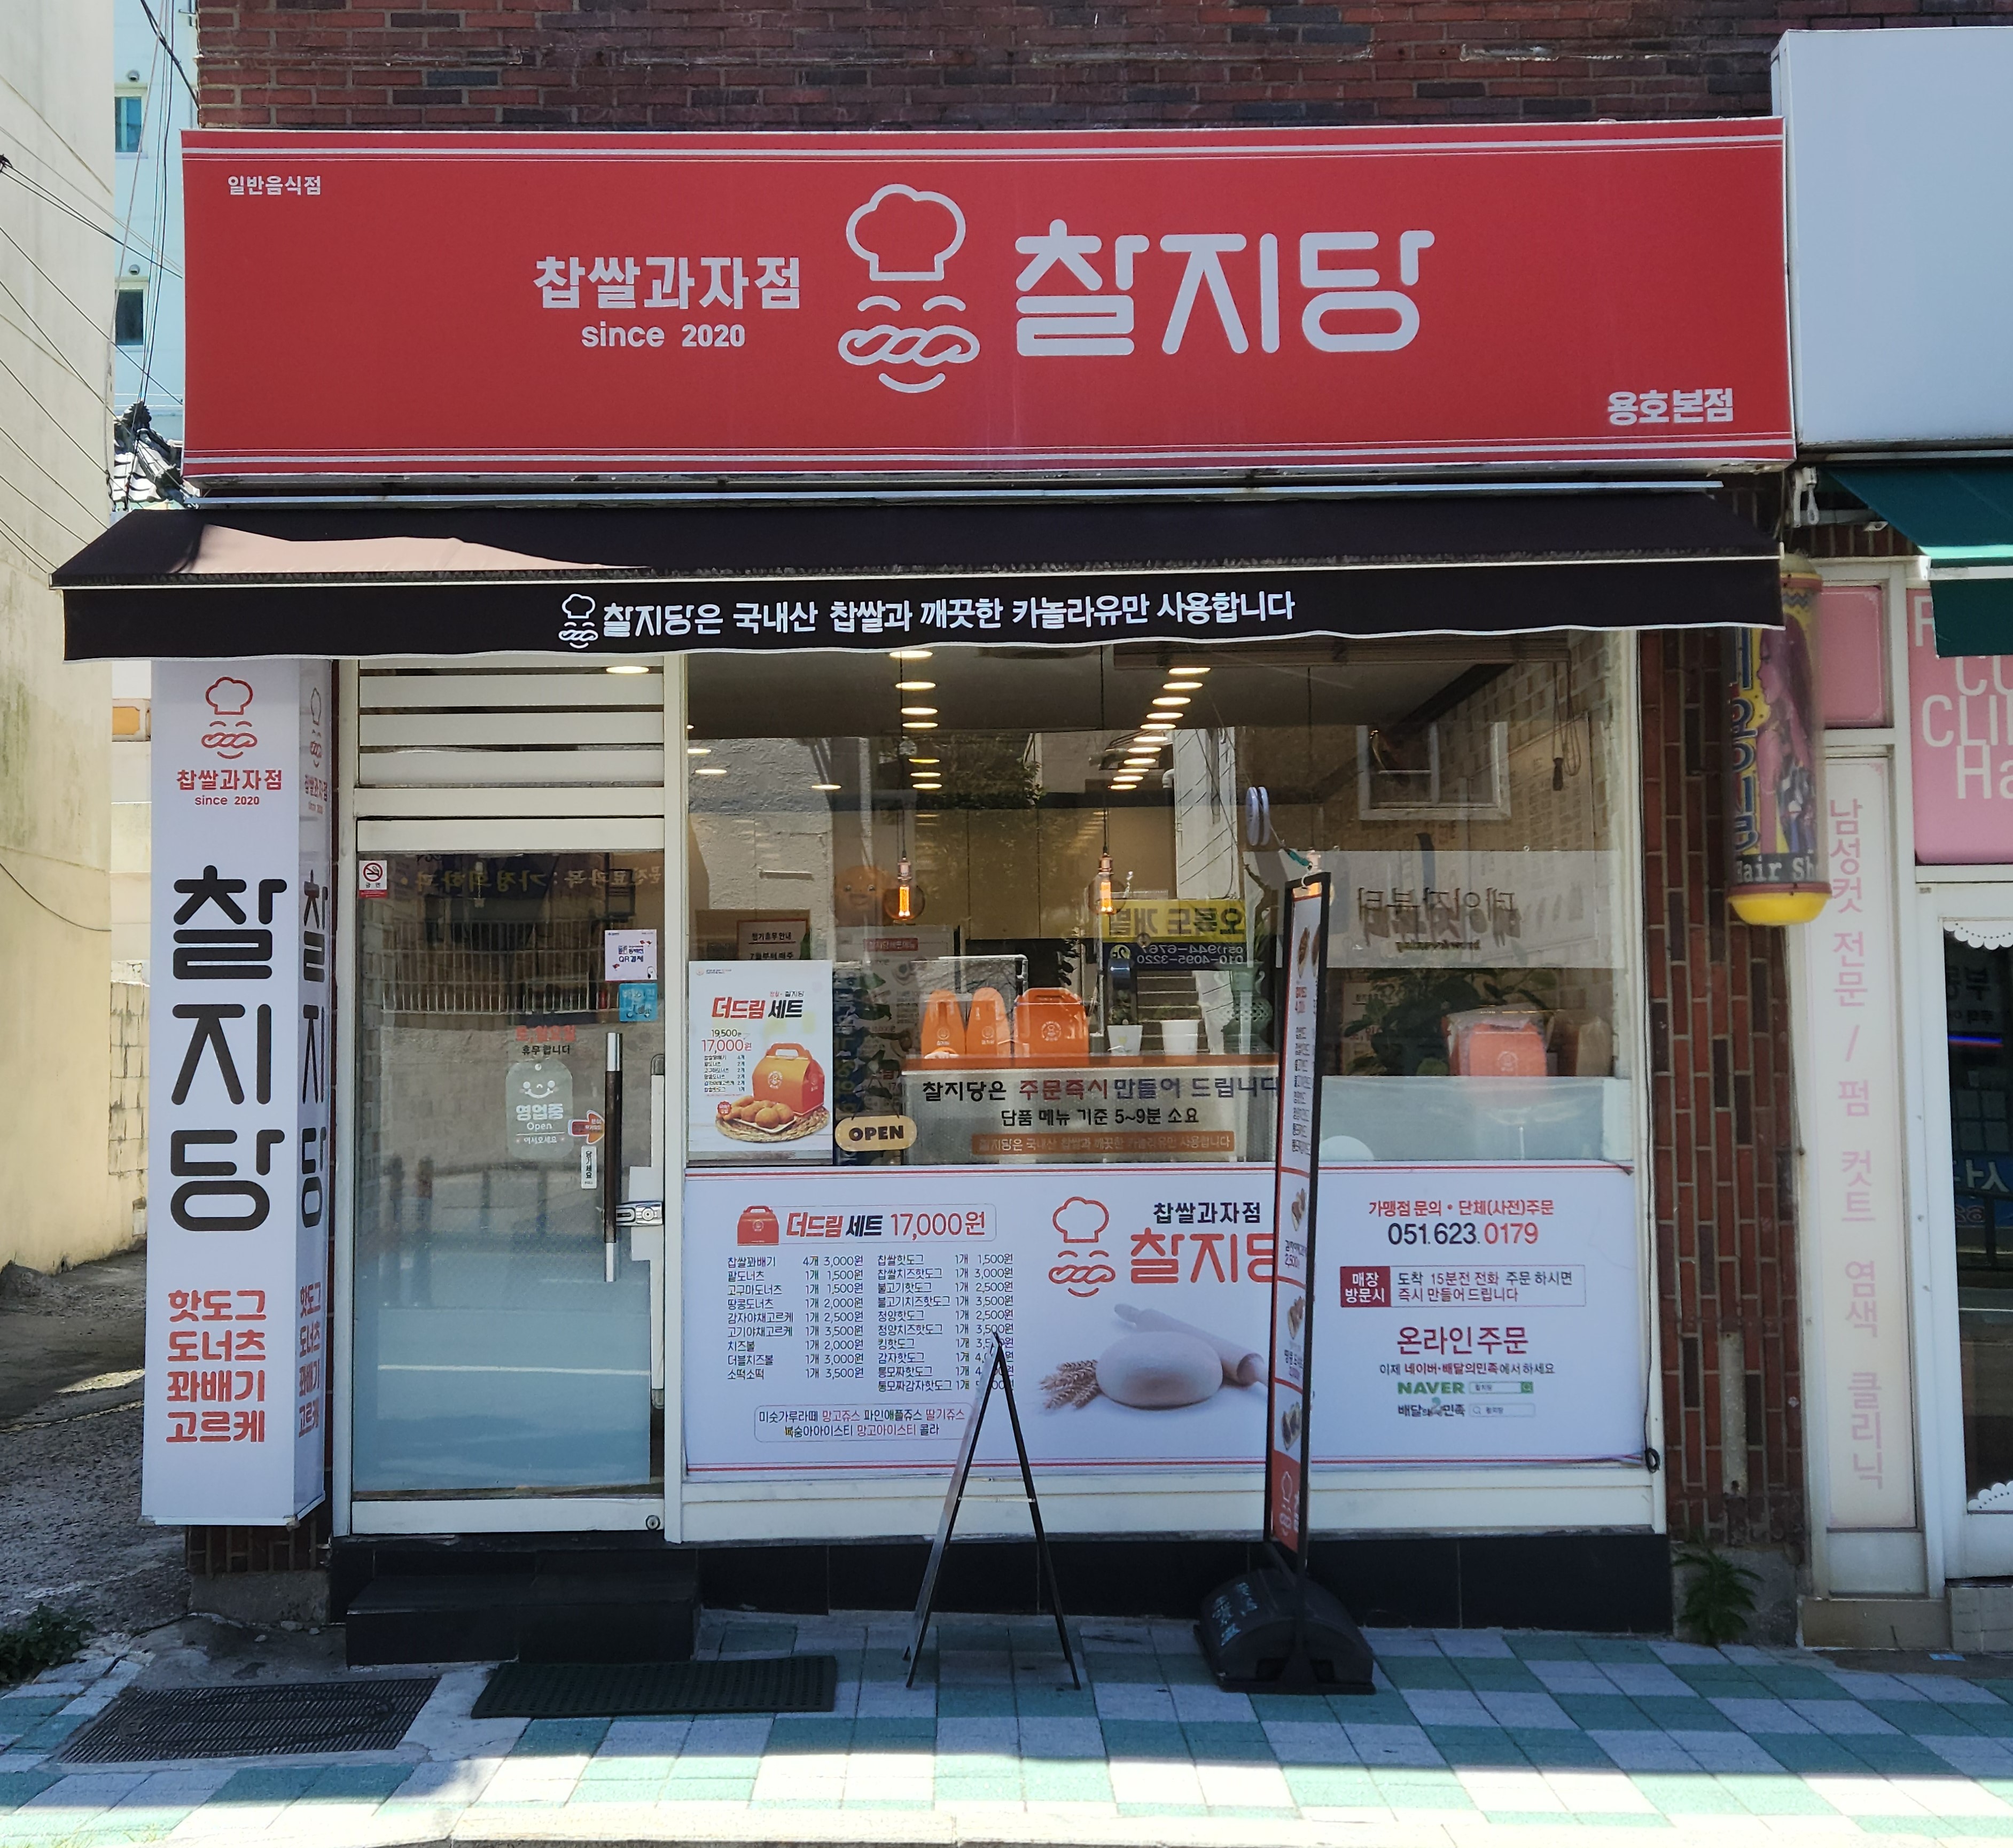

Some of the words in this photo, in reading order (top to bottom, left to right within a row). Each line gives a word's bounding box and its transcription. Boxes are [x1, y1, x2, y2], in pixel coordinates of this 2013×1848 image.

[228, 174, 322, 197] 일반음식점
[534, 256, 800, 310] 찹쌀과자점
[1015, 218, 1435, 356] 찰지당
[582, 322, 664, 348] since
[682, 324, 746, 348] 2020
[1607, 387, 1734, 425] 용호본점
[603, 603, 723, 637] 찰지당은
[733, 601, 818, 634] 국내산
[830, 601, 913, 633] 찹쌀과
[920, 598, 1003, 629] 깨끗한
[1013, 594, 1150, 629] 카놀라유만
[1157, 591, 1296, 626] 사용합니다
[1923, 695, 2013, 746] CLI
[176, 769, 283, 791] 찹쌀과자점
[195, 795, 228, 806] since
[234, 796, 260, 806] 2020
[1830, 799, 1863, 914] 남성컷
[1833, 931, 1868, 1007] 전문
[712, 997, 766, 1019] 더드림
[768, 1000, 803, 1019] 세트
[170, 865, 287, 1231] 찰지당
[701, 1040, 752, 1054] 17,000원
[923, 1080, 1007, 1102] 찰지당은
[1019, 1079, 1107, 1101] 주문즉시
[1114, 1078, 1180, 1099] 만들어
[1838, 1080, 1870, 1117] 펌
[516, 1104, 563, 1121] 영업중
[1001, 1109, 1032, 1126] 단품
[1039, 1108, 1070, 1126] 메뉴
[1077, 1108, 1107, 1125] 기준
[1114, 1108, 1161, 1125] 5~9분
[1168, 1108, 1199, 1122] 소요
[527, 1122, 552, 1130] Open
[848, 1126, 904, 1143] OPEN
[1841, 1150, 1876, 1222] 컷트
[1153, 1202, 1261, 1224] 찹쌀과자점
[1369, 1200, 1411, 1217] 가맹점
[1414, 1200, 1442, 1217] 문의
[1459, 1199, 1554, 1216] 단체(사전)주문
[786, 1212, 844, 1238] 더드림
[845, 1214, 883, 1237] 세트
[890, 1211, 986, 1241] 17,000원
[1388, 1222, 1539, 1245] 051.623.0179
[728, 1257, 775, 1268] 찹쌀꽈배기
[803, 1256, 818, 1266] 4개
[824, 1255, 863, 1268] 3,000원
[878, 1254, 924, 1266] 찹쌀핫도그
[955, 1254, 968, 1264] 1개
[978, 1253, 1013, 1265] 1,500원
[728, 1270, 764, 1282] 팥도너츠
[806, 1270, 818, 1280] 1개
[827, 1269, 863, 1281] 1,500원
[878, 1268, 942, 1280] 찹쌀치즈핫도그
[955, 1268, 968, 1278] 1개
[974, 1267, 1013, 1280] 3,000원
[1352, 1272, 1379, 1288] 매장
[1398, 1272, 1423, 1286] 도착
[1431, 1272, 1470, 1286] 15분전
[1474, 1272, 1499, 1286] 전화
[1506, 1272, 1531, 1286] 주문
[1534, 1272, 1572, 1286] 하시면
[806, 1284, 818, 1294] 1개
[827, 1283, 863, 1294] 1,500원
[955, 1282, 968, 1292] 1개
[976, 1281, 1013, 1293] 2,500원
[1345, 1288, 1385, 1303] 방문시
[1398, 1288, 1423, 1302] 즉시
[1427, 1288, 1465, 1302] 만들어
[1468, 1288, 1518, 1302] 드립니다
[168, 1290, 267, 1323] 핫도그
[728, 1298, 774, 1310] 땅콩도너츠
[805, 1298, 818, 1308] 1개
[824, 1297, 863, 1309] 2,000원
[956, 1296, 969, 1306] 1개
[976, 1295, 1013, 1307] 3,500원
[1845, 1261, 1878, 1337] 염색
[728, 1312, 793, 1324] 감자야채고르케
[806, 1312, 818, 1322] 1개
[824, 1311, 863, 1323] 2,500원
[956, 1309, 969, 1320] 1개
[976, 1309, 1013, 1321] 2,500원
[728, 1326, 792, 1337] 고기야채고르케
[806, 1325, 818, 1336] 1개
[825, 1325, 863, 1337] 3,500원
[955, 1323, 969, 1334] 1개
[167, 1330, 266, 1362] 도너츠
[728, 1340, 754, 1352] 치즈볼
[806, 1339, 819, 1351] 1개
[824, 1339, 863, 1352] 2,000원
[976, 1337, 1013, 1350] 3,50원
[1397, 1326, 1471, 1355] 온라인
[1478, 1327, 1528, 1355] 주문
[728, 1355, 774, 1366] 더블치즈볼
[805, 1354, 819, 1364] 1개
[824, 1353, 863, 1365] 3,000원
[878, 1352, 925, 1364] 감자핫도그
[975, 1351, 1013, 1364] 4,원
[728, 1368, 764, 1380] 소떡소떡
[806, 1368, 819, 1378] 1개
[825, 1367, 864, 1379] 3,500원
[1380, 1364, 1400, 1375] 이제
[167, 1369, 266, 1402] 꽈배기
[1398, 1382, 1465, 1394] NAVER
[759, 1410, 818, 1423] 미숫가루라떼
[822, 1410, 860, 1422] 망고쥬스
[864, 1409, 922, 1422] 파인애플쥬스
[926, 1408, 965, 1421] 딸기쥬스
[166, 1410, 266, 1442] 고르케
[857, 1424, 917, 1437] 망고아이스티
[919, 1423, 939, 1436] 콜라
[1847, 1371, 1883, 1490] 클리닉
